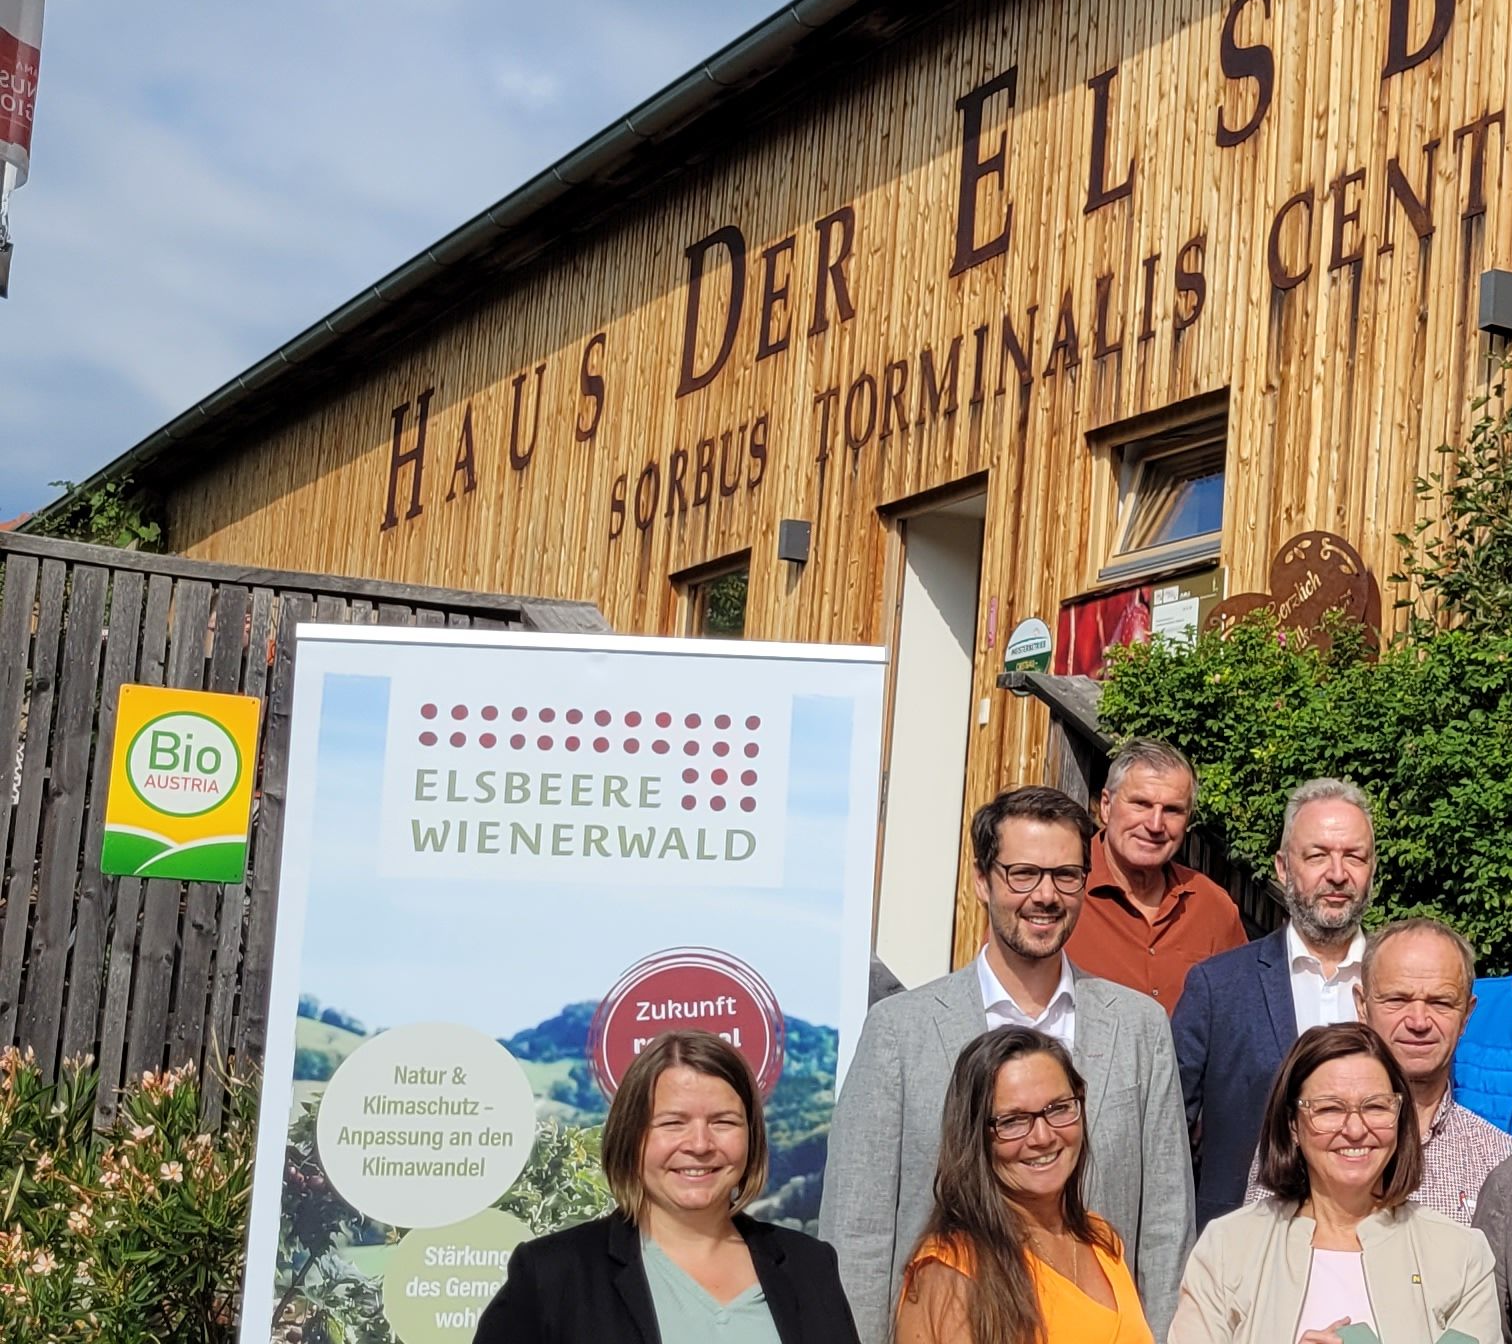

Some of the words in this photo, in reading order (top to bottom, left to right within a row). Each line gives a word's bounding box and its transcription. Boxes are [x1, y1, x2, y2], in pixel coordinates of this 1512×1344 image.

[381, 333, 606, 533] HAUS
[675, 206, 856, 399] DER
[610, 413, 768, 540] SORBUS
[812, 233, 1207, 462] TORMINALIS
[148, 729, 222, 775] Bio
[144, 774, 219, 794] AUSTRIA
[414, 768, 662, 809] ELSBEERE
[411, 818, 757, 862] WIENERWALD
[636, 996, 737, 1021] Zukunft
[394, 1066, 447, 1086] Natur
[451, 1067, 467, 1085] &
[363, 1095, 479, 1116] Klimaschutz
[337, 1126, 444, 1149] Anpassung
[449, 1131, 473, 1146] an
[478, 1127, 513, 1146] den
[362, 1157, 486, 1177] Klimawandel
[424, 1245, 512, 1272] Stärkung
[405, 1275, 441, 1297] des
[446, 1277, 503, 1297] Geme
